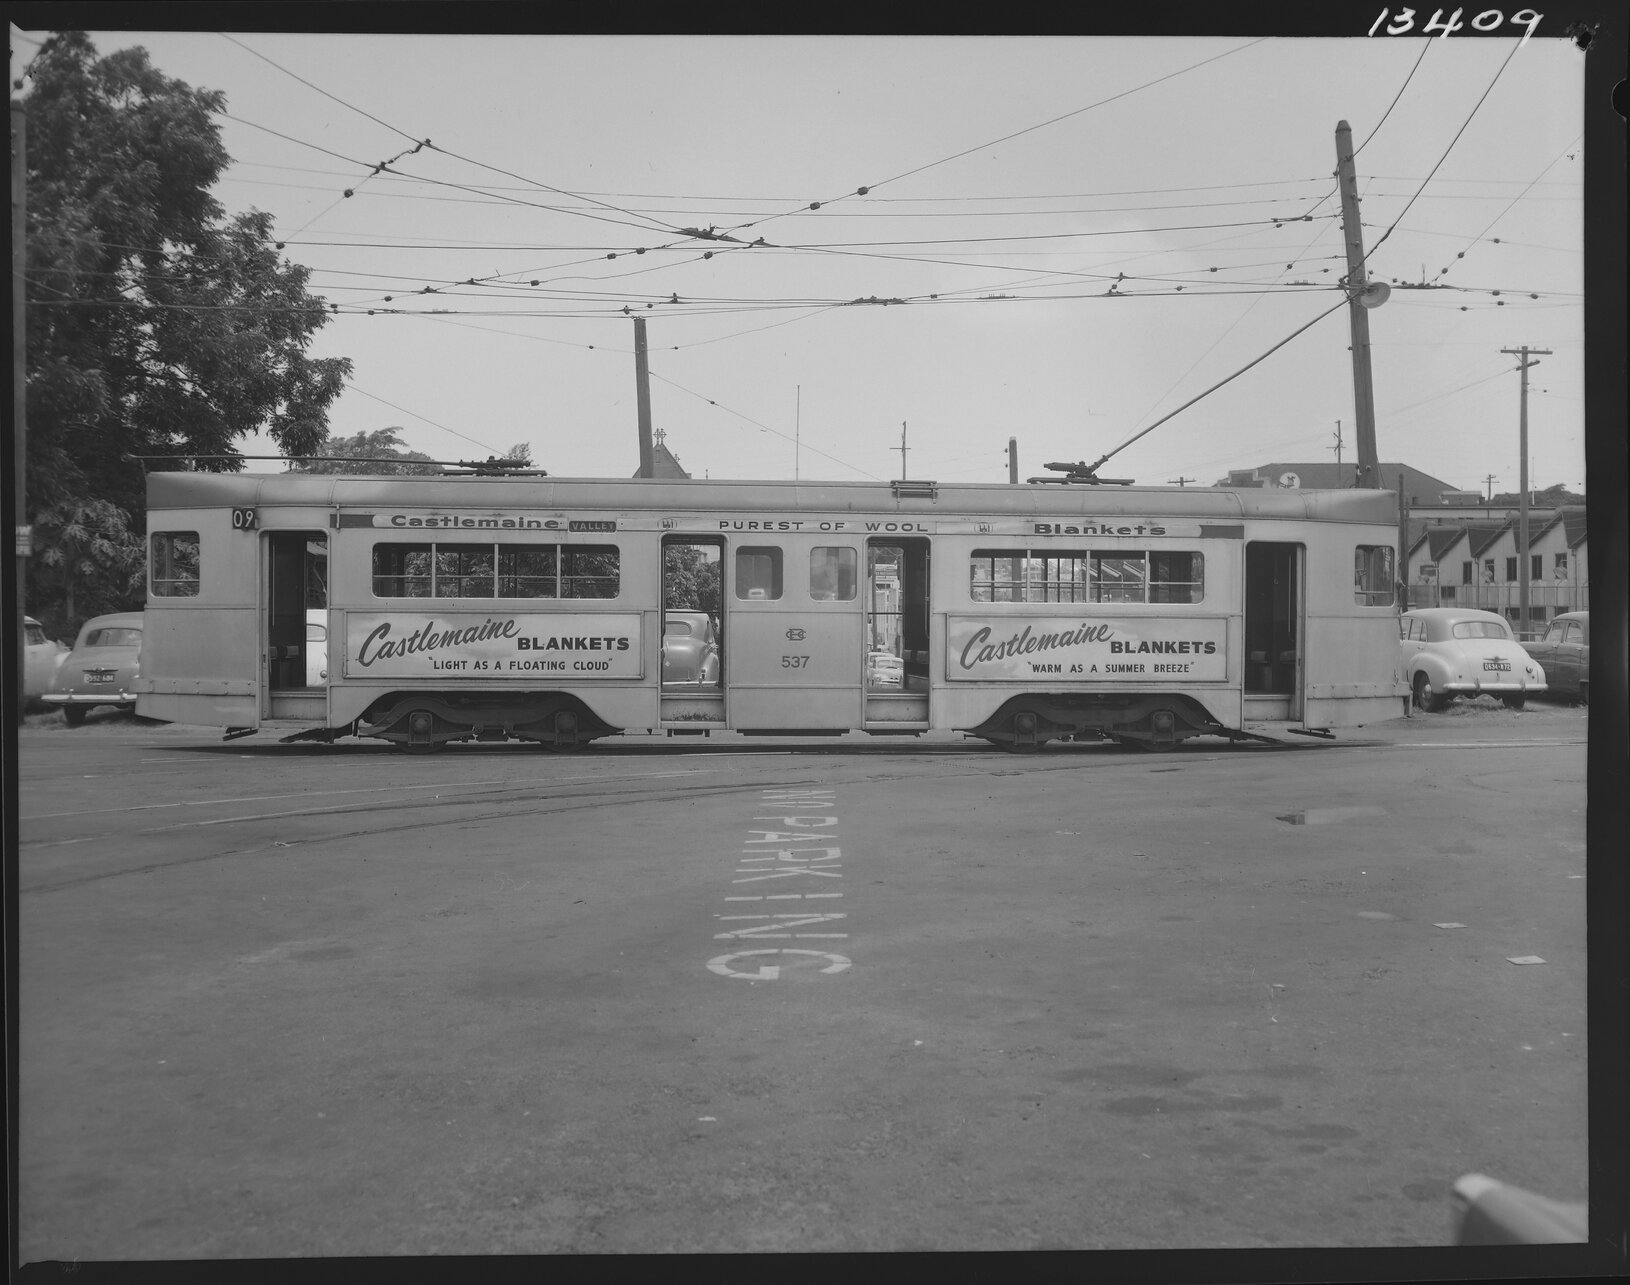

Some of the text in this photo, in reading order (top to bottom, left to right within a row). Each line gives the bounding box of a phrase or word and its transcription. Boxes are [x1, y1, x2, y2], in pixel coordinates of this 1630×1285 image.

[1368, 7, 1544, 47] 13409
[233, 510, 254, 528] 09
[391, 514, 560, 529] Castlemaine
[571, 521, 615, 531] VALLEY
[719, 521, 929, 533] PUREST OF WOOL
[1034, 523, 1166, 536] Blankets
[358, 618, 630, 667] Castlemaine BLANKETS
[959, 622, 1217, 670] Castlemaine BLANKETS
[473, 660, 489, 670] AS
[494, 660, 502, 670] A
[509, 660, 566, 671] FLOATING
[781, 656, 810, 668] 537
[1070, 663, 1084, 673] AS
[1090, 663, 1098, 673] A
[1105, 663, 1146, 673] SUMMER
[706, 790, 852, 980] NO PARKING
